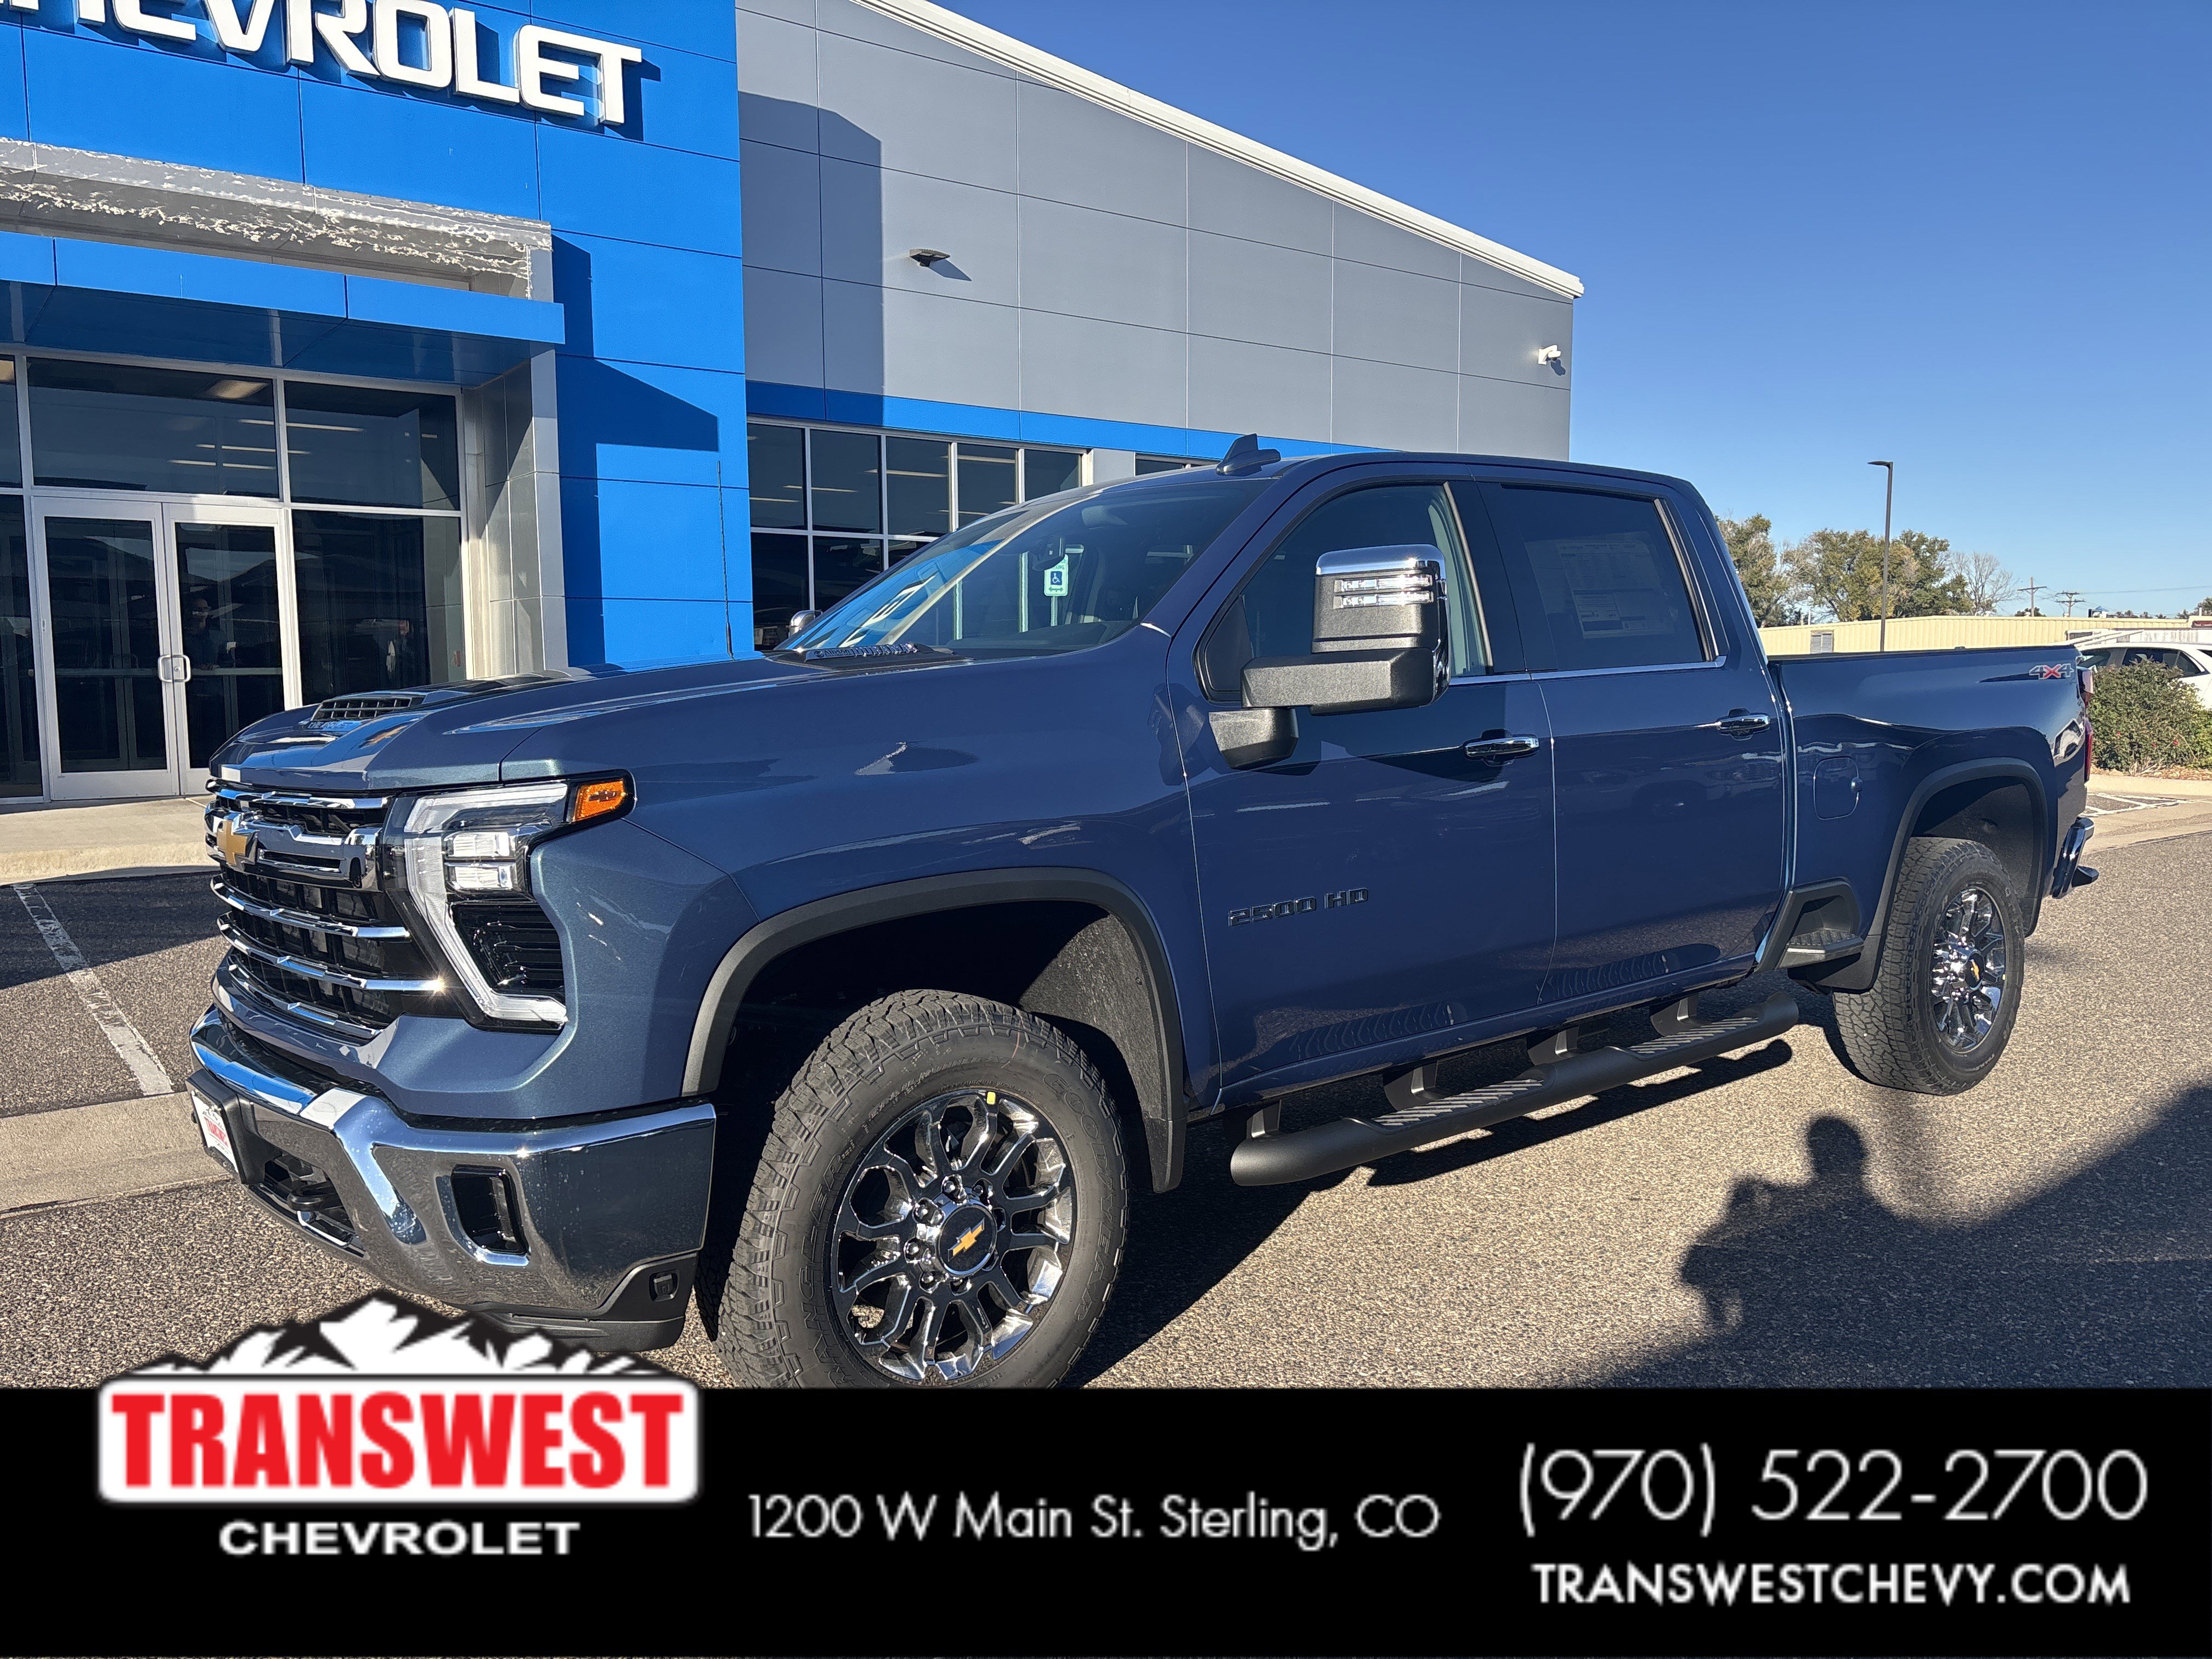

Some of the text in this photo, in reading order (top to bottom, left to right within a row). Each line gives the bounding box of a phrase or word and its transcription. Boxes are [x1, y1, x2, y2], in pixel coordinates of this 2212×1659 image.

[1228, 887, 1368, 927] 2500 HD
[1042, 1073, 1114, 1321] GOODYEAR
